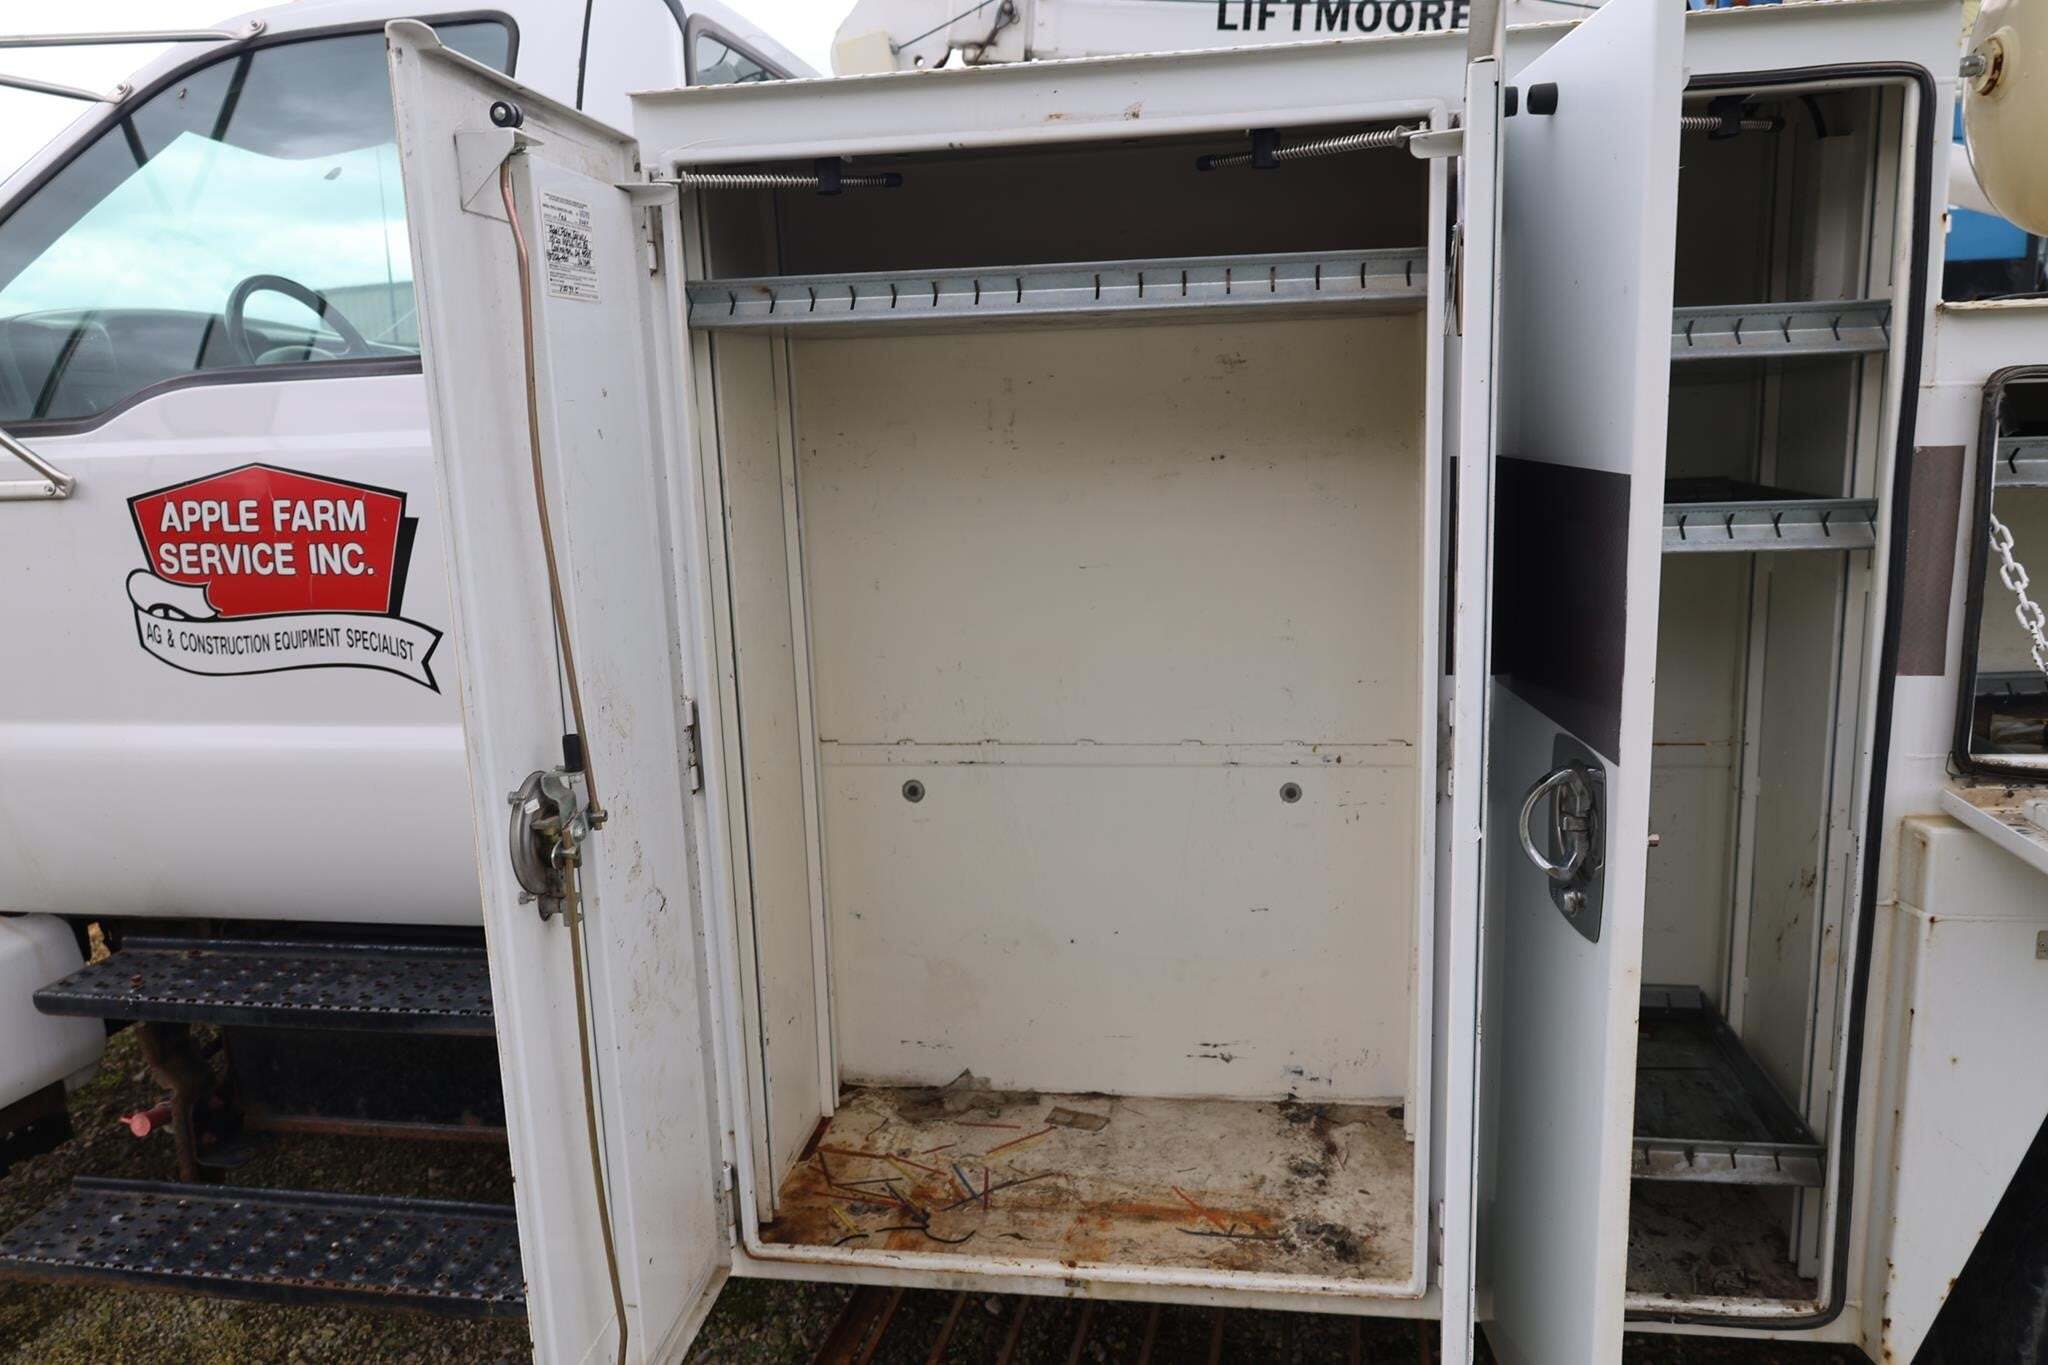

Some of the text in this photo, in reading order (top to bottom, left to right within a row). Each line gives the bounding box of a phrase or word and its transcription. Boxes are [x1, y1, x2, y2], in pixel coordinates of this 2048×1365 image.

[1217, 0, 1470, 32] LIFTMOORE
[160, 499, 367, 533] APPLE FARM
[159, 542, 375, 576] SERVICE INC.
[146, 622, 414, 661] AG & CONSTRUCTION EQUIPMENT SPECIALIST
